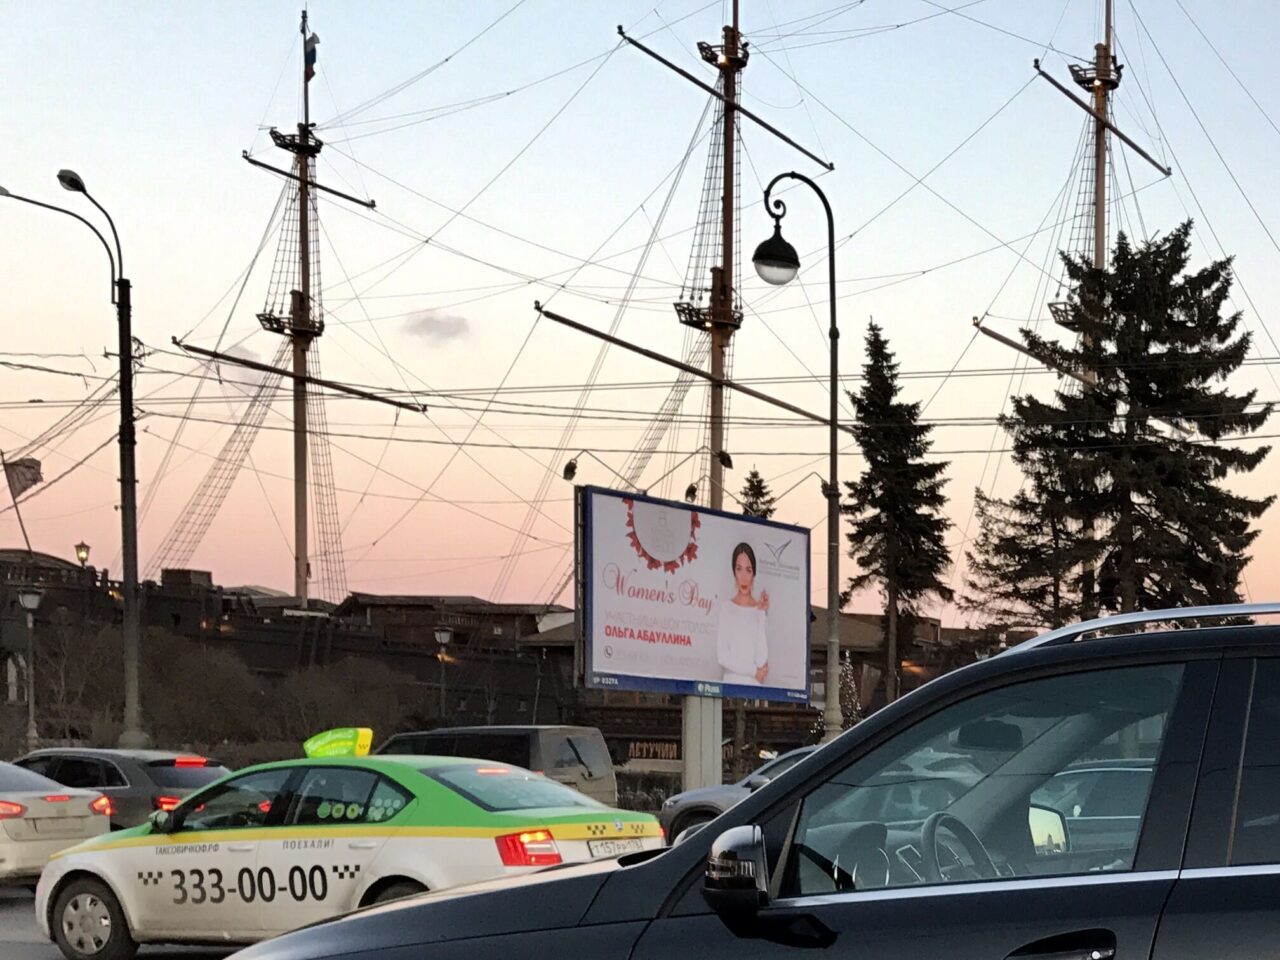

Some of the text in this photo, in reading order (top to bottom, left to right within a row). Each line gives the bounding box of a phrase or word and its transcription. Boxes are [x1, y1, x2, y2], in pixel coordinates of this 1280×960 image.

[603, 562, 713, 616] Women's Day
[605, 625, 692, 647] ОЛЬГА АБДУЛЛИНА
[155, 843, 220, 856] ТАКСОВИЧКОФ.РФ
[282, 839, 335, 850] ПОЕХАЛИ!
[170, 864, 328, 905] 333-00-00
